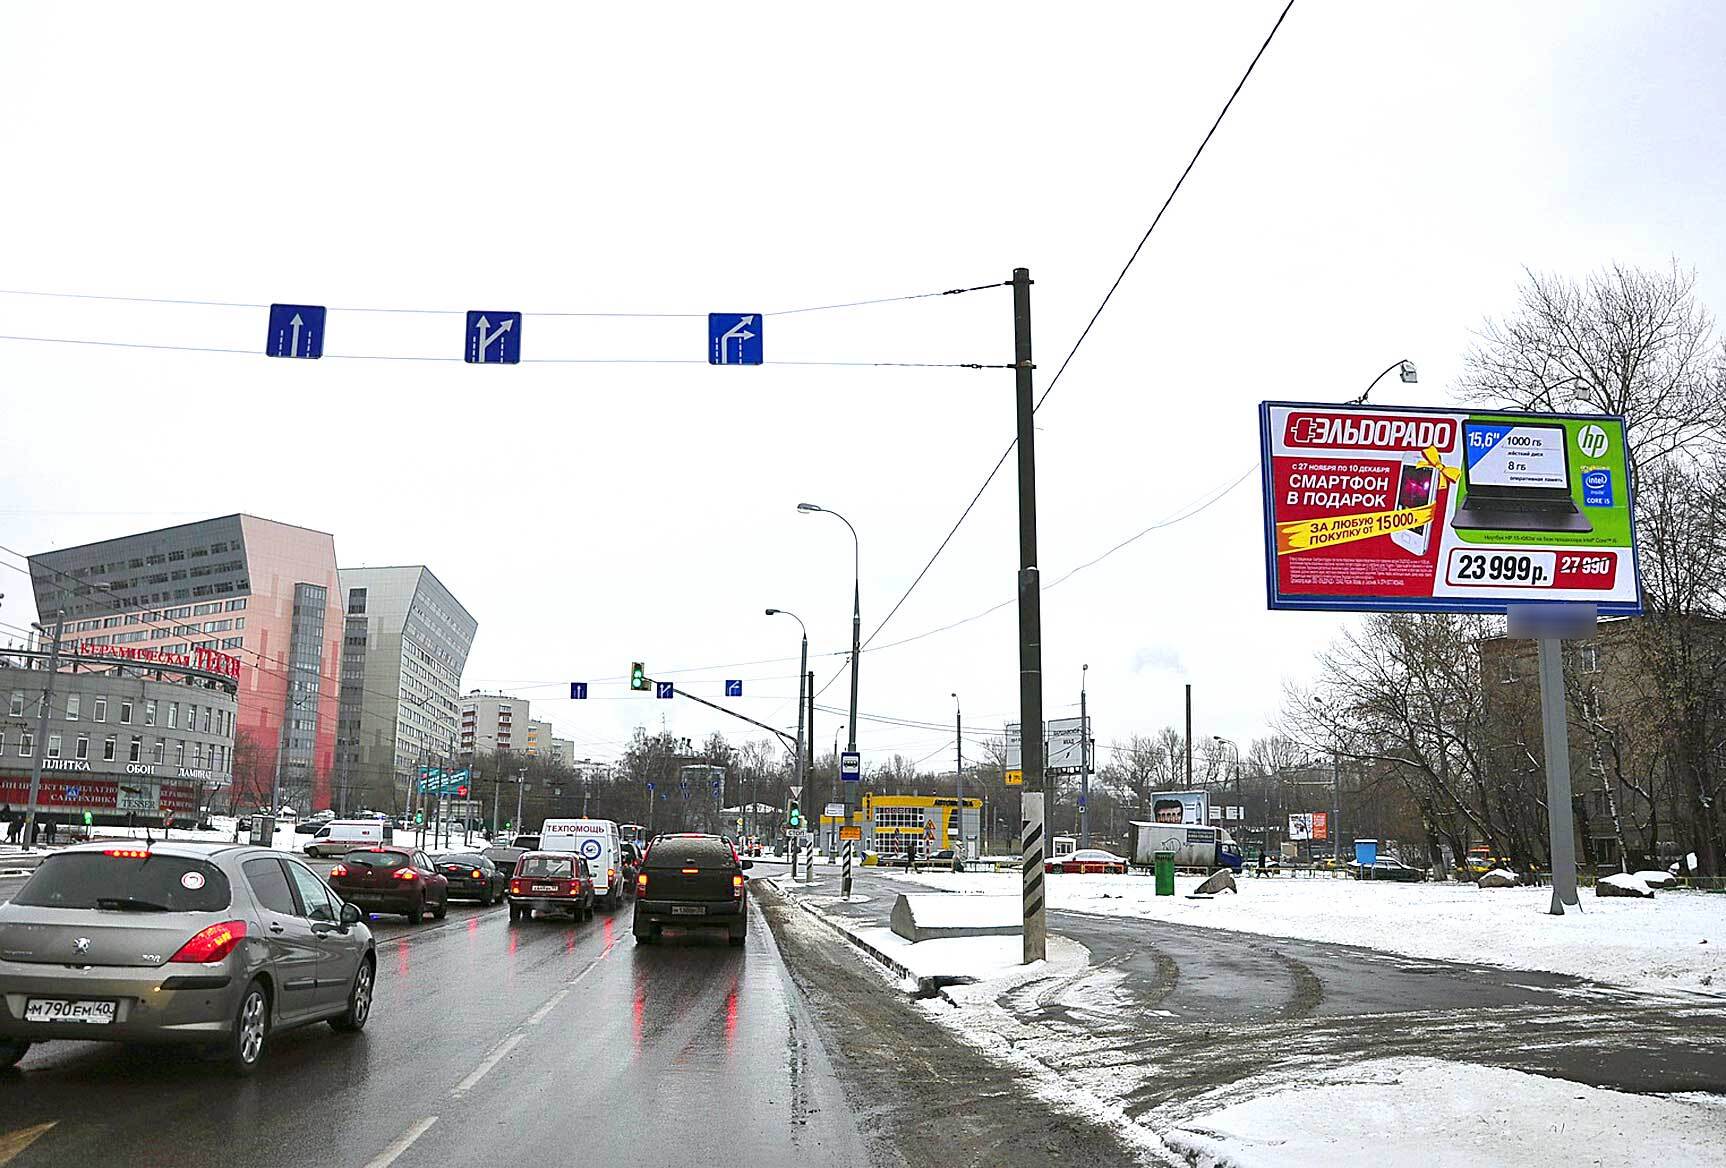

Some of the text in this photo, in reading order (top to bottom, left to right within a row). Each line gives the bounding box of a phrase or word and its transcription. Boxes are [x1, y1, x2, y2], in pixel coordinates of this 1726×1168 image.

[1507, 436, 1531, 446] 1000
[1582, 425, 1605, 457] hp
[1359, 466, 1390, 474] ДЕКАБРЯ
[1508, 460, 1514, 470] 8
[1289, 473, 1389, 491] СМАРТФОН
[1286, 491, 1387, 509] В ПОДАРОК
[1310, 517, 1374, 533] ЗА ЛЮБУЮ
[1310, 526, 1373, 545] ПОКУПКУ ОТ
[81, 642, 190, 667] КЕРАМИЧЕСКАЯ
[42, 759, 91, 771] ПЛИТКА
[126, 764, 155, 775] ОБОИ
[178, 767, 212, 779] ЛАМИНАТ
[121, 799, 156, 809] TESSER
[546, 824, 605, 834] ТЕХПОМОЩЬ
[95, 1003, 110, 1015] 40
